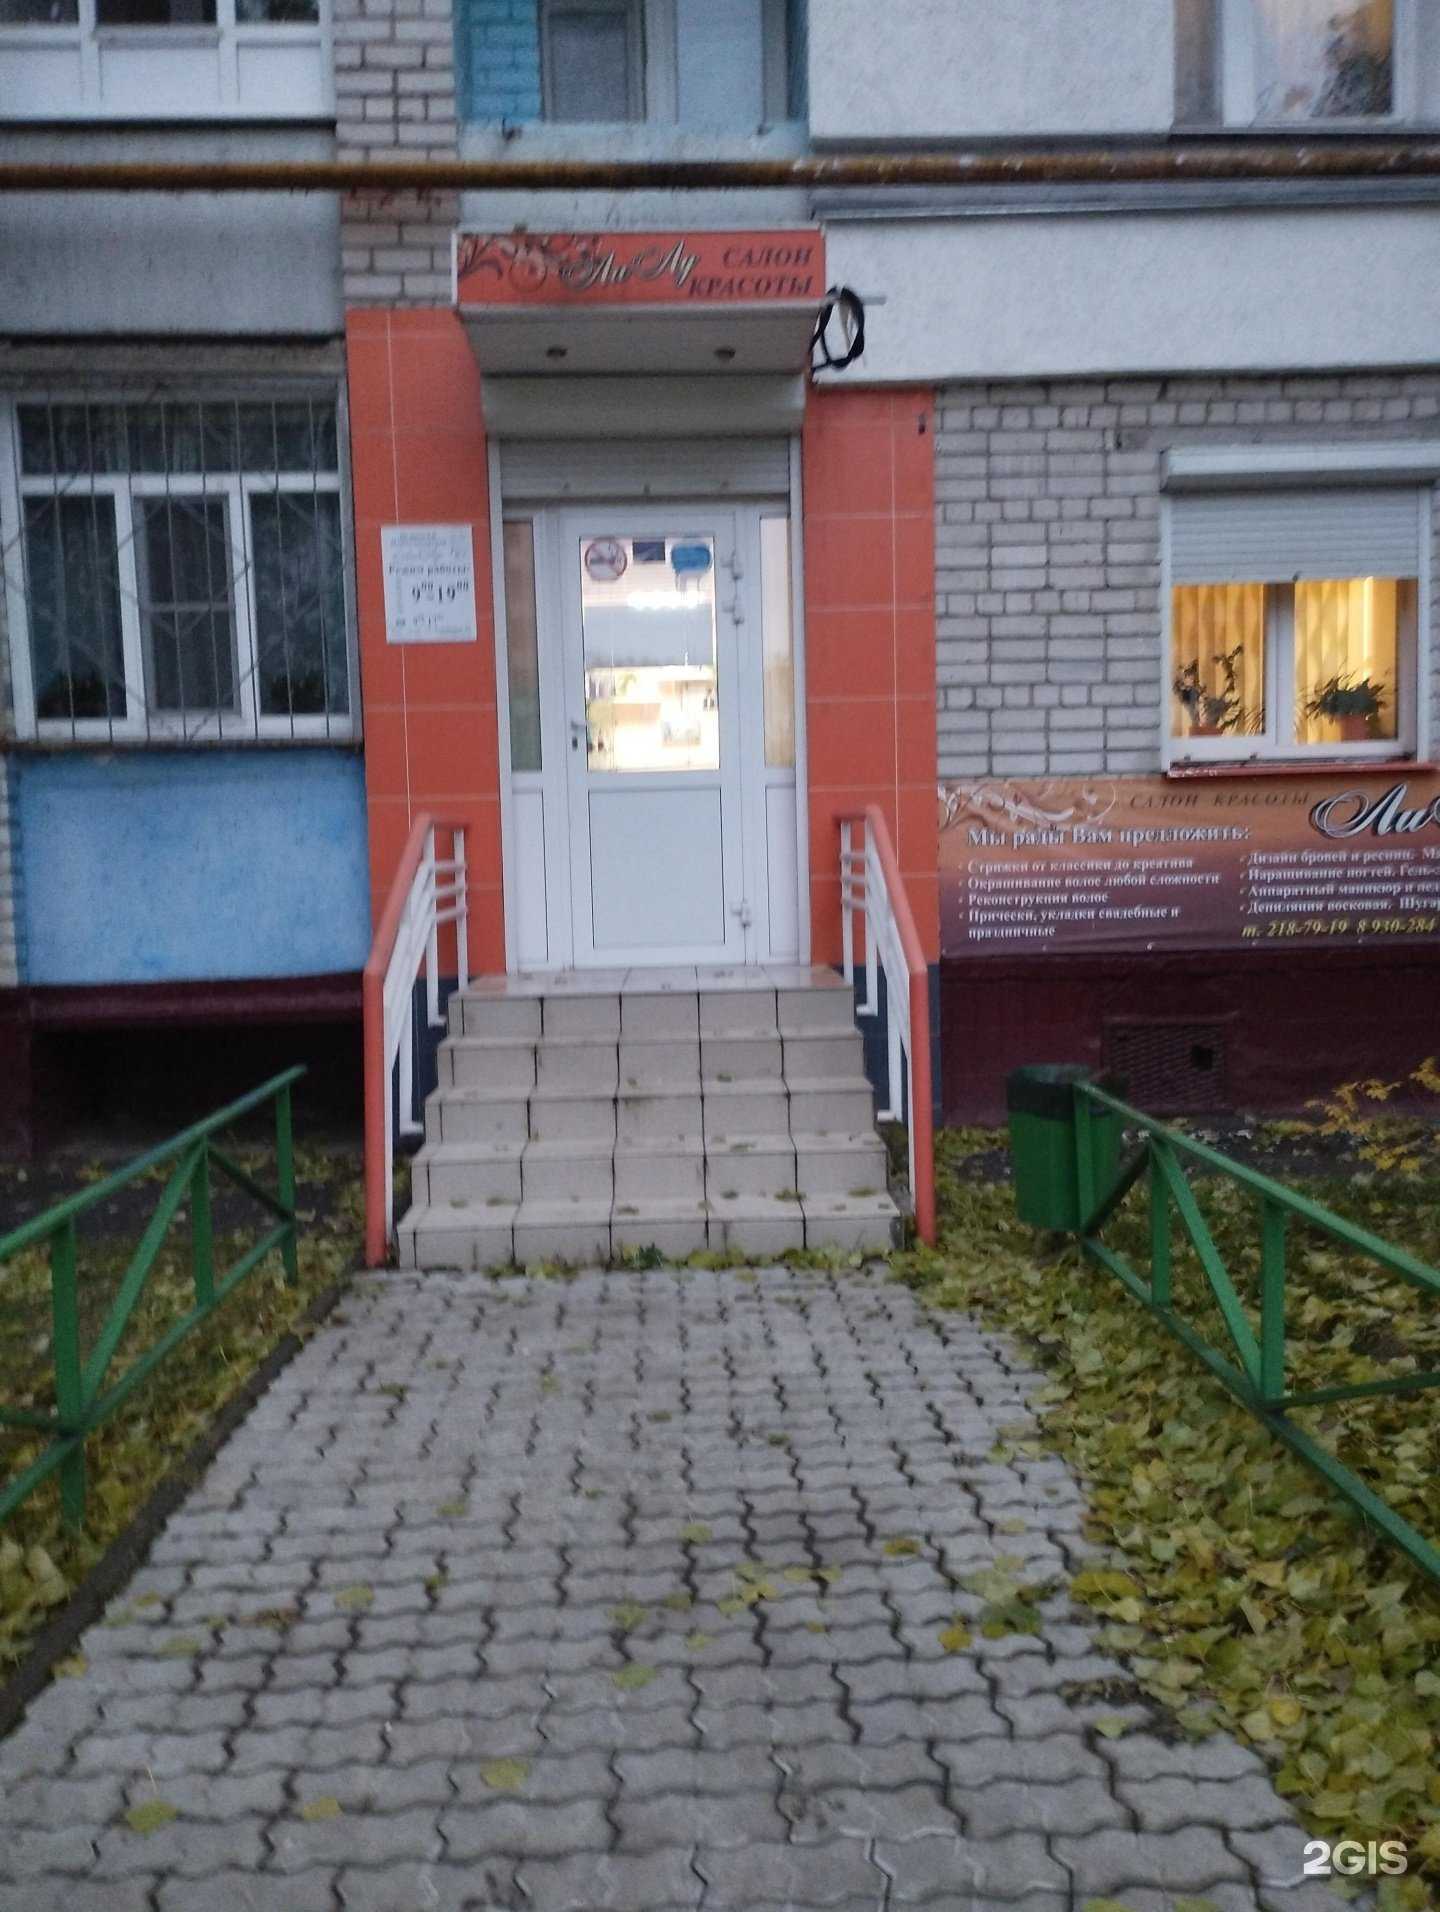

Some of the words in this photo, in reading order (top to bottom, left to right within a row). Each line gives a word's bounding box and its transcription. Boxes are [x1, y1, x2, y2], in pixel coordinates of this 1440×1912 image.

[723, 247, 811, 267] САЛОН
[689, 276, 811, 296] КРАСОТЫ
[1129, 794, 1199, 809] САЛОН
[1213, 791, 1309, 806] КРАСОТЫ
[967, 829, 1007, 846] Мы
[1013, 828, 1065, 848] рады
[1072, 826, 1113, 844] Вам
[1119, 824, 1251, 846] предложить:
[1247, 851, 1297, 866] Дизайн
[1301, 851, 1348, 864] бровей
[1351, 853, 1360, 863] и
[967, 860, 1029, 875] Стрижки
[1032, 862, 1047, 873] от
[1050, 861, 1112, 873] классики
[1115, 861, 1130, 873] до
[1248, 868, 1342, 884] Наращивание
[967, 877, 1062, 893] Окрашивание
[1065, 878, 1101, 889] волос
[1104, 874, 1147, 887] любой
[1150, 873, 1220, 888] сложности
[1248, 883, 1335, 899] Аппаратный
[1337, 882, 1402, 896] маникюр
[967, 894, 1068, 910] Реконструкция
[1071, 894, 1109, 905] волос
[1248, 900, 1324, 915] Депиляция
[1040, 909, 1096, 923] укладки
[1098, 906, 1169, 920] свадебные
[1171, 908, 1180, 919] и
[968, 926, 1057, 941] праздничные
[1267, 919, 1348, 938] 218-79-19
[1356, 920, 1367, 934] 8
